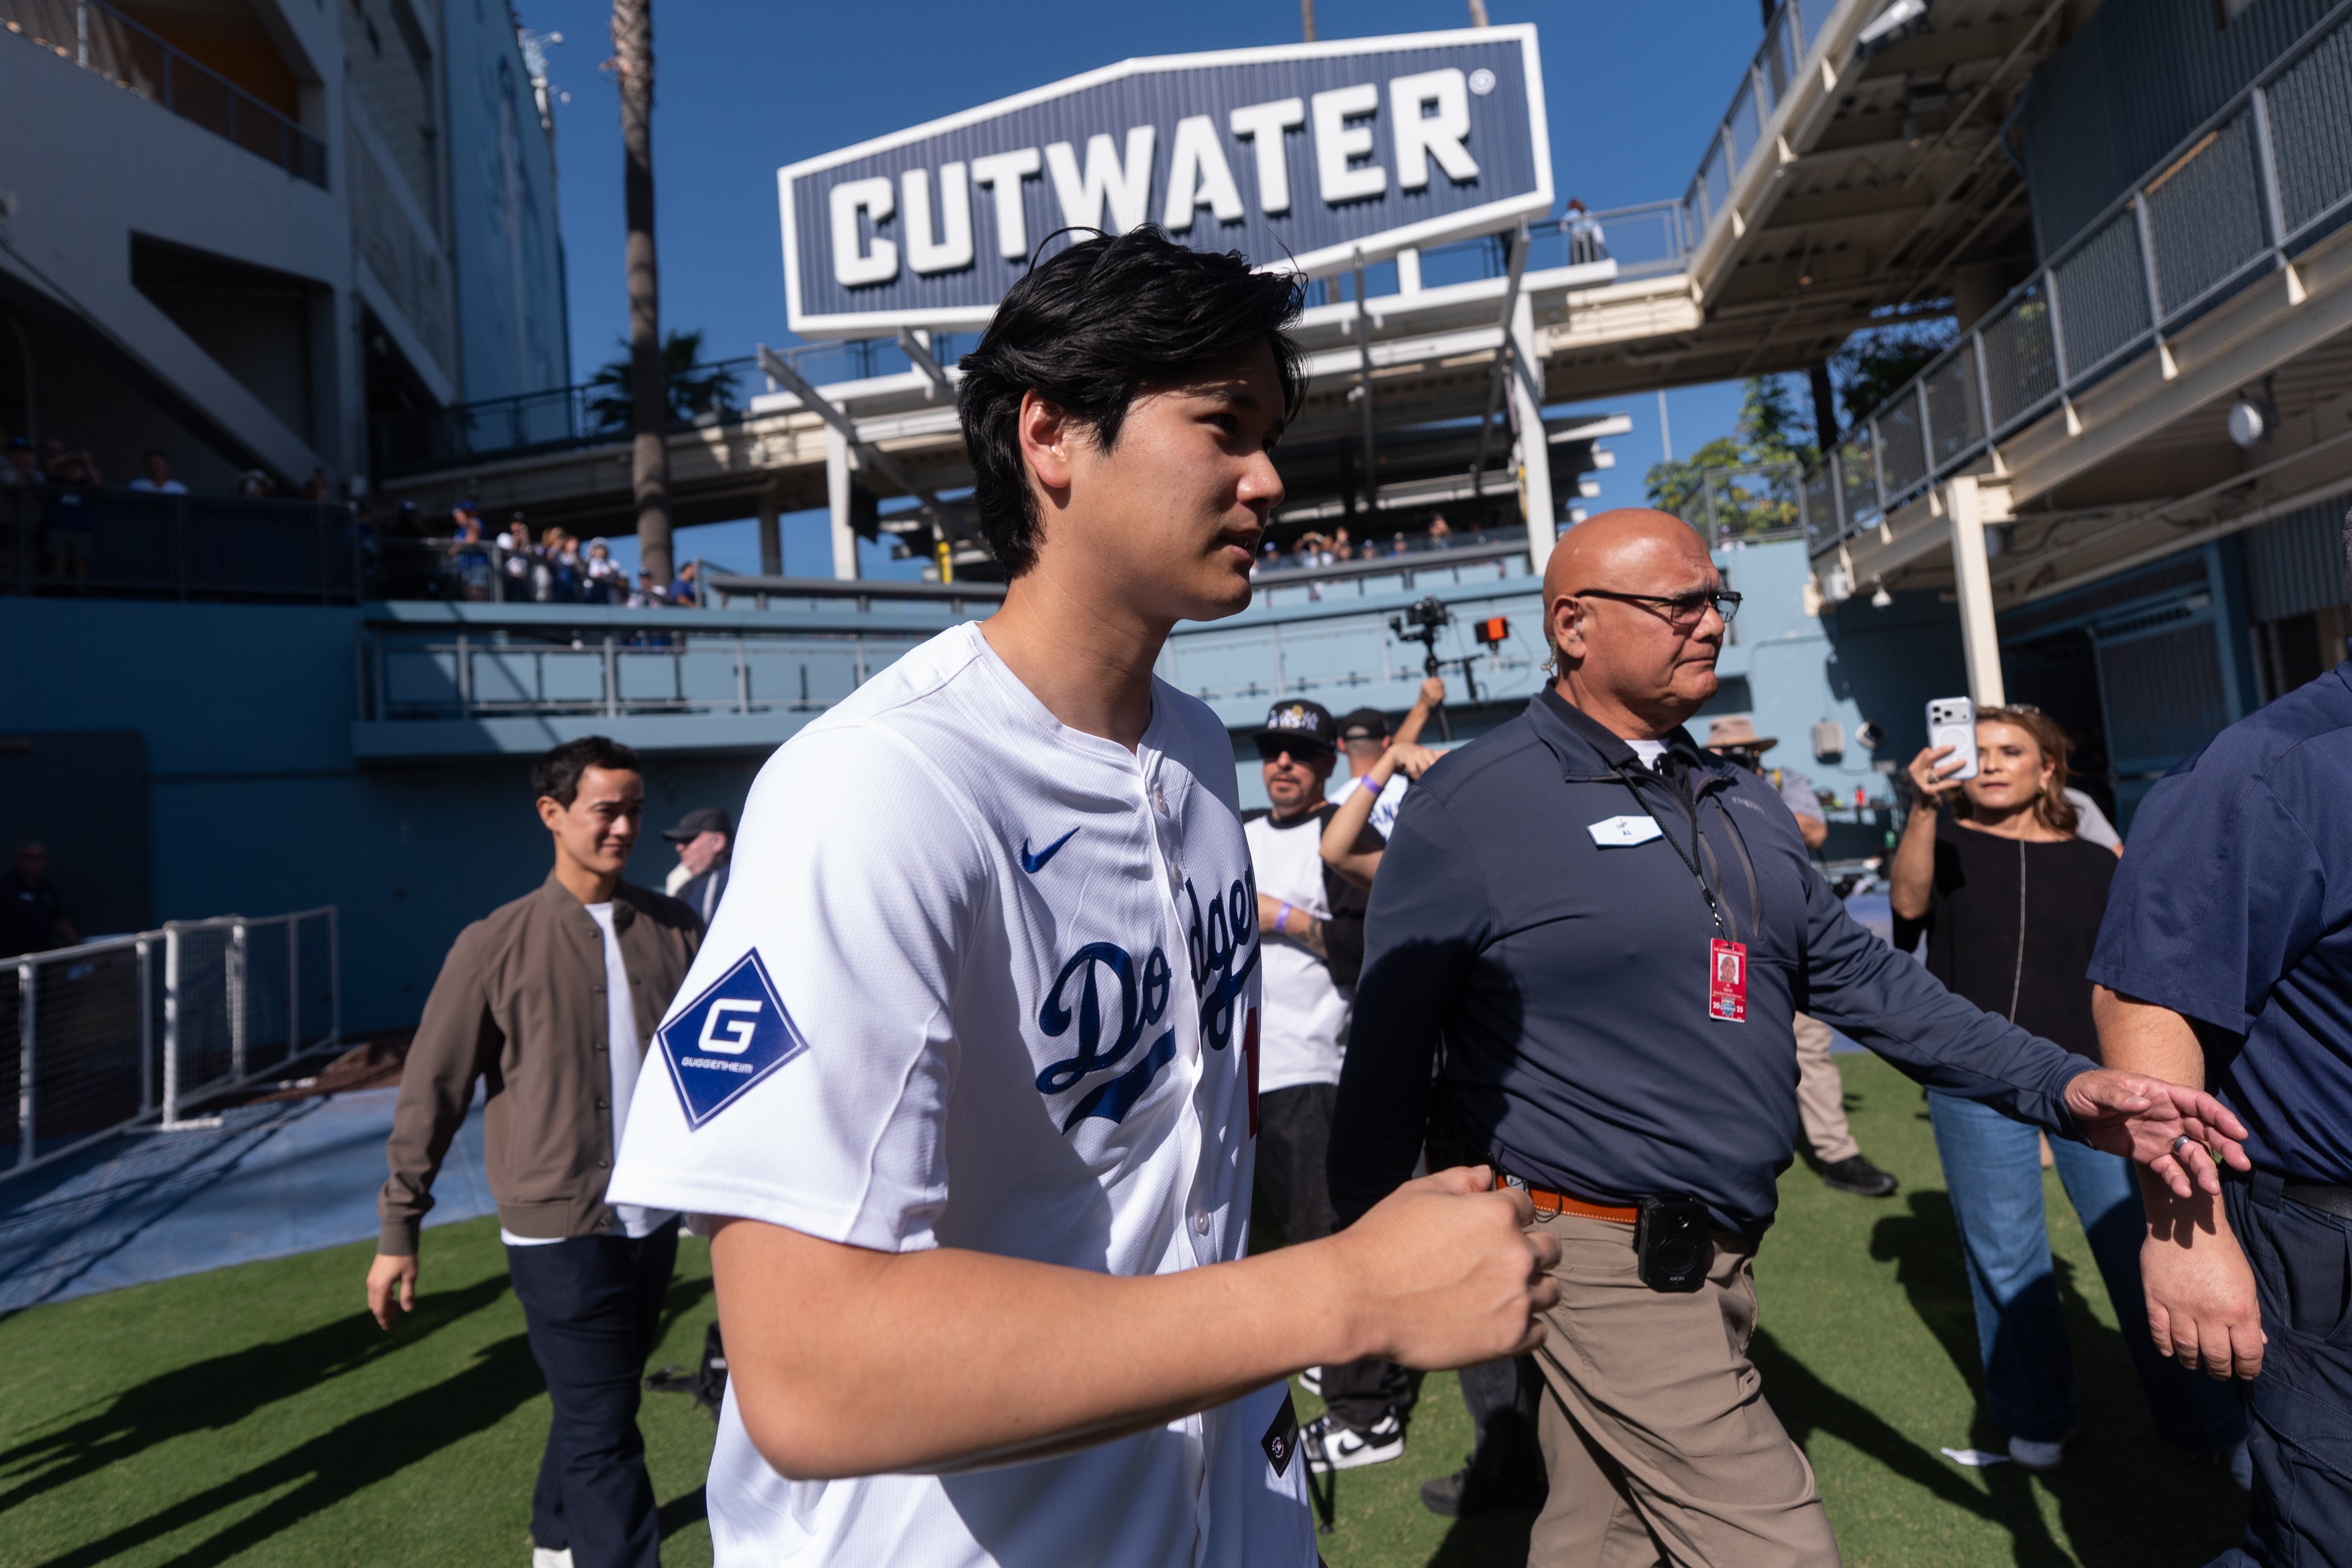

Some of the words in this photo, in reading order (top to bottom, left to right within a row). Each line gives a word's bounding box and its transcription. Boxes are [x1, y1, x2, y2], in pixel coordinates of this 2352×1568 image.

[829, 67, 1480, 288] CUTWATER
[1036, 862, 1260, 1095] Dodger
[698, 998, 762, 1055] G
[1713, 1001, 1720, 1010] 20
[1736, 1005, 1744, 1014] 25
[681, 1056, 753, 1074] GUGGENHEIM
